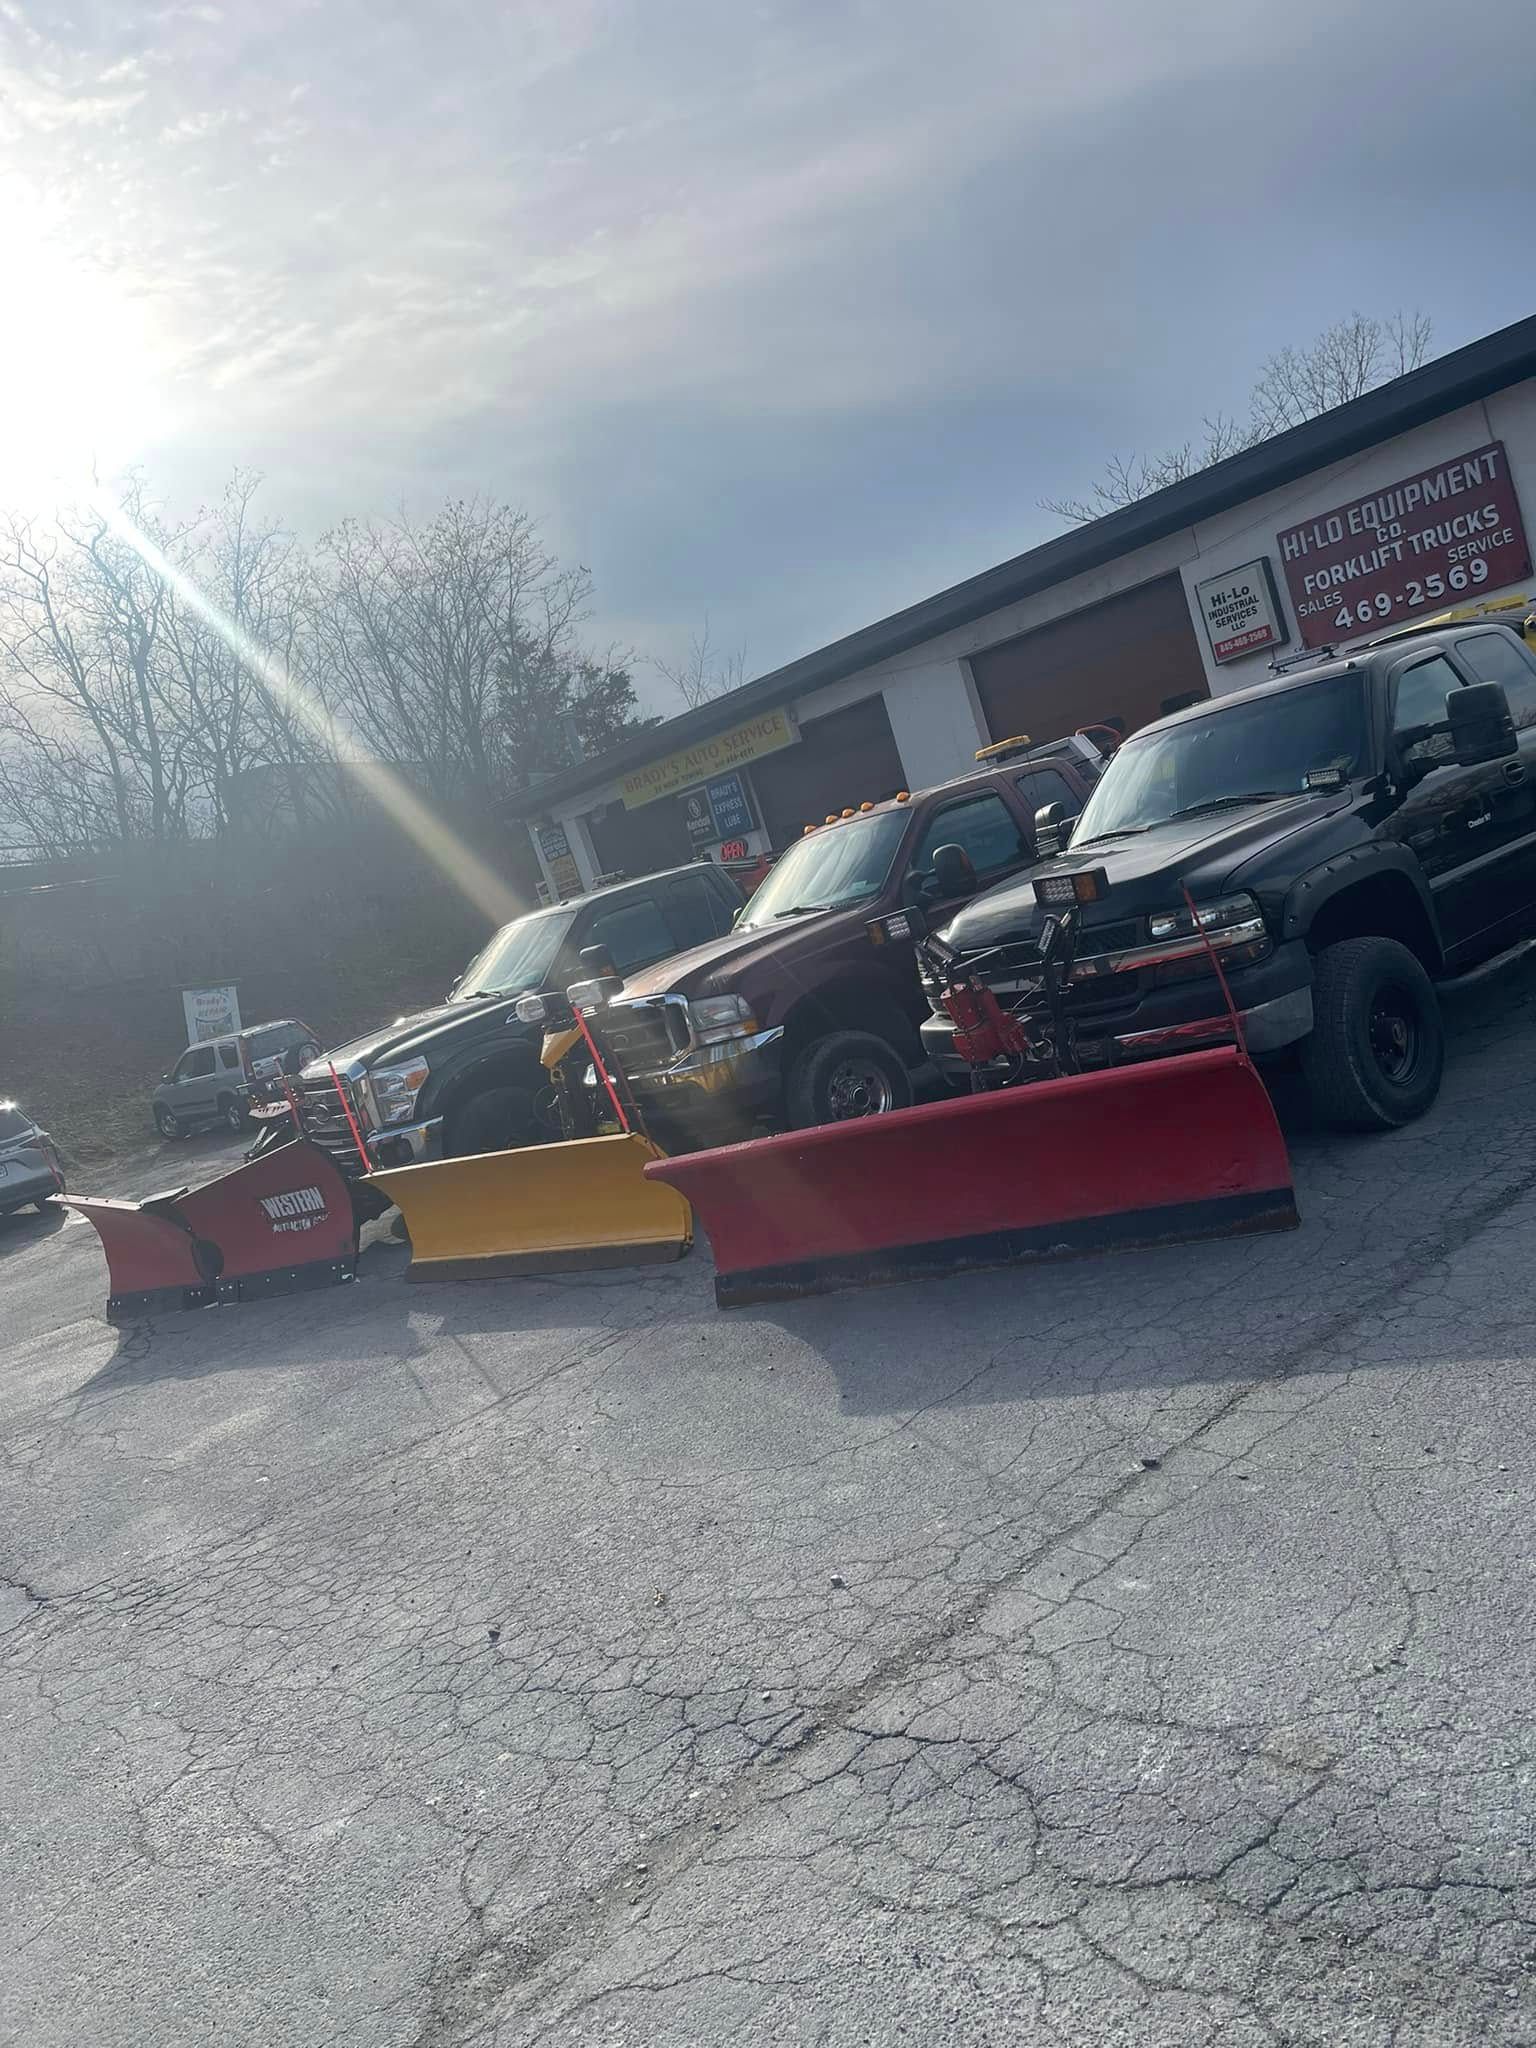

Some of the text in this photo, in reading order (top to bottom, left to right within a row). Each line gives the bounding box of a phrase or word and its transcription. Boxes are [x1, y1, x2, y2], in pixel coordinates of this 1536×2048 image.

[1282, 451, 1499, 562] HI-LO EQUIPMENT
[1376, 523, 1406, 543] CO.
[1304, 504, 1500, 595] FORKLIFT TRUCKS
[1448, 528, 1514, 563] SERVICE
[1211, 586, 1250, 607] Hi-Lo
[1298, 592, 1343, 617] SALES
[1334, 558, 1489, 629] 469-2569
[1208, 594, 1260, 621] INDUSTRIAL
[1215, 605, 1258, 628] SERVICES
[1231, 620, 1246, 631] LLC
[624, 758, 681, 793] BRADY'S
[685, 746, 720, 770] AUTO
[722, 716, 783, 750] SERVICE
[710, 782, 738, 800] BRADY'S
[714, 797, 744, 815] EXPRESS
[724, 814, 742, 828] LUBE
[721, 841, 745, 861] OPEN
[260, 1186, 325, 1218] WESTERN
